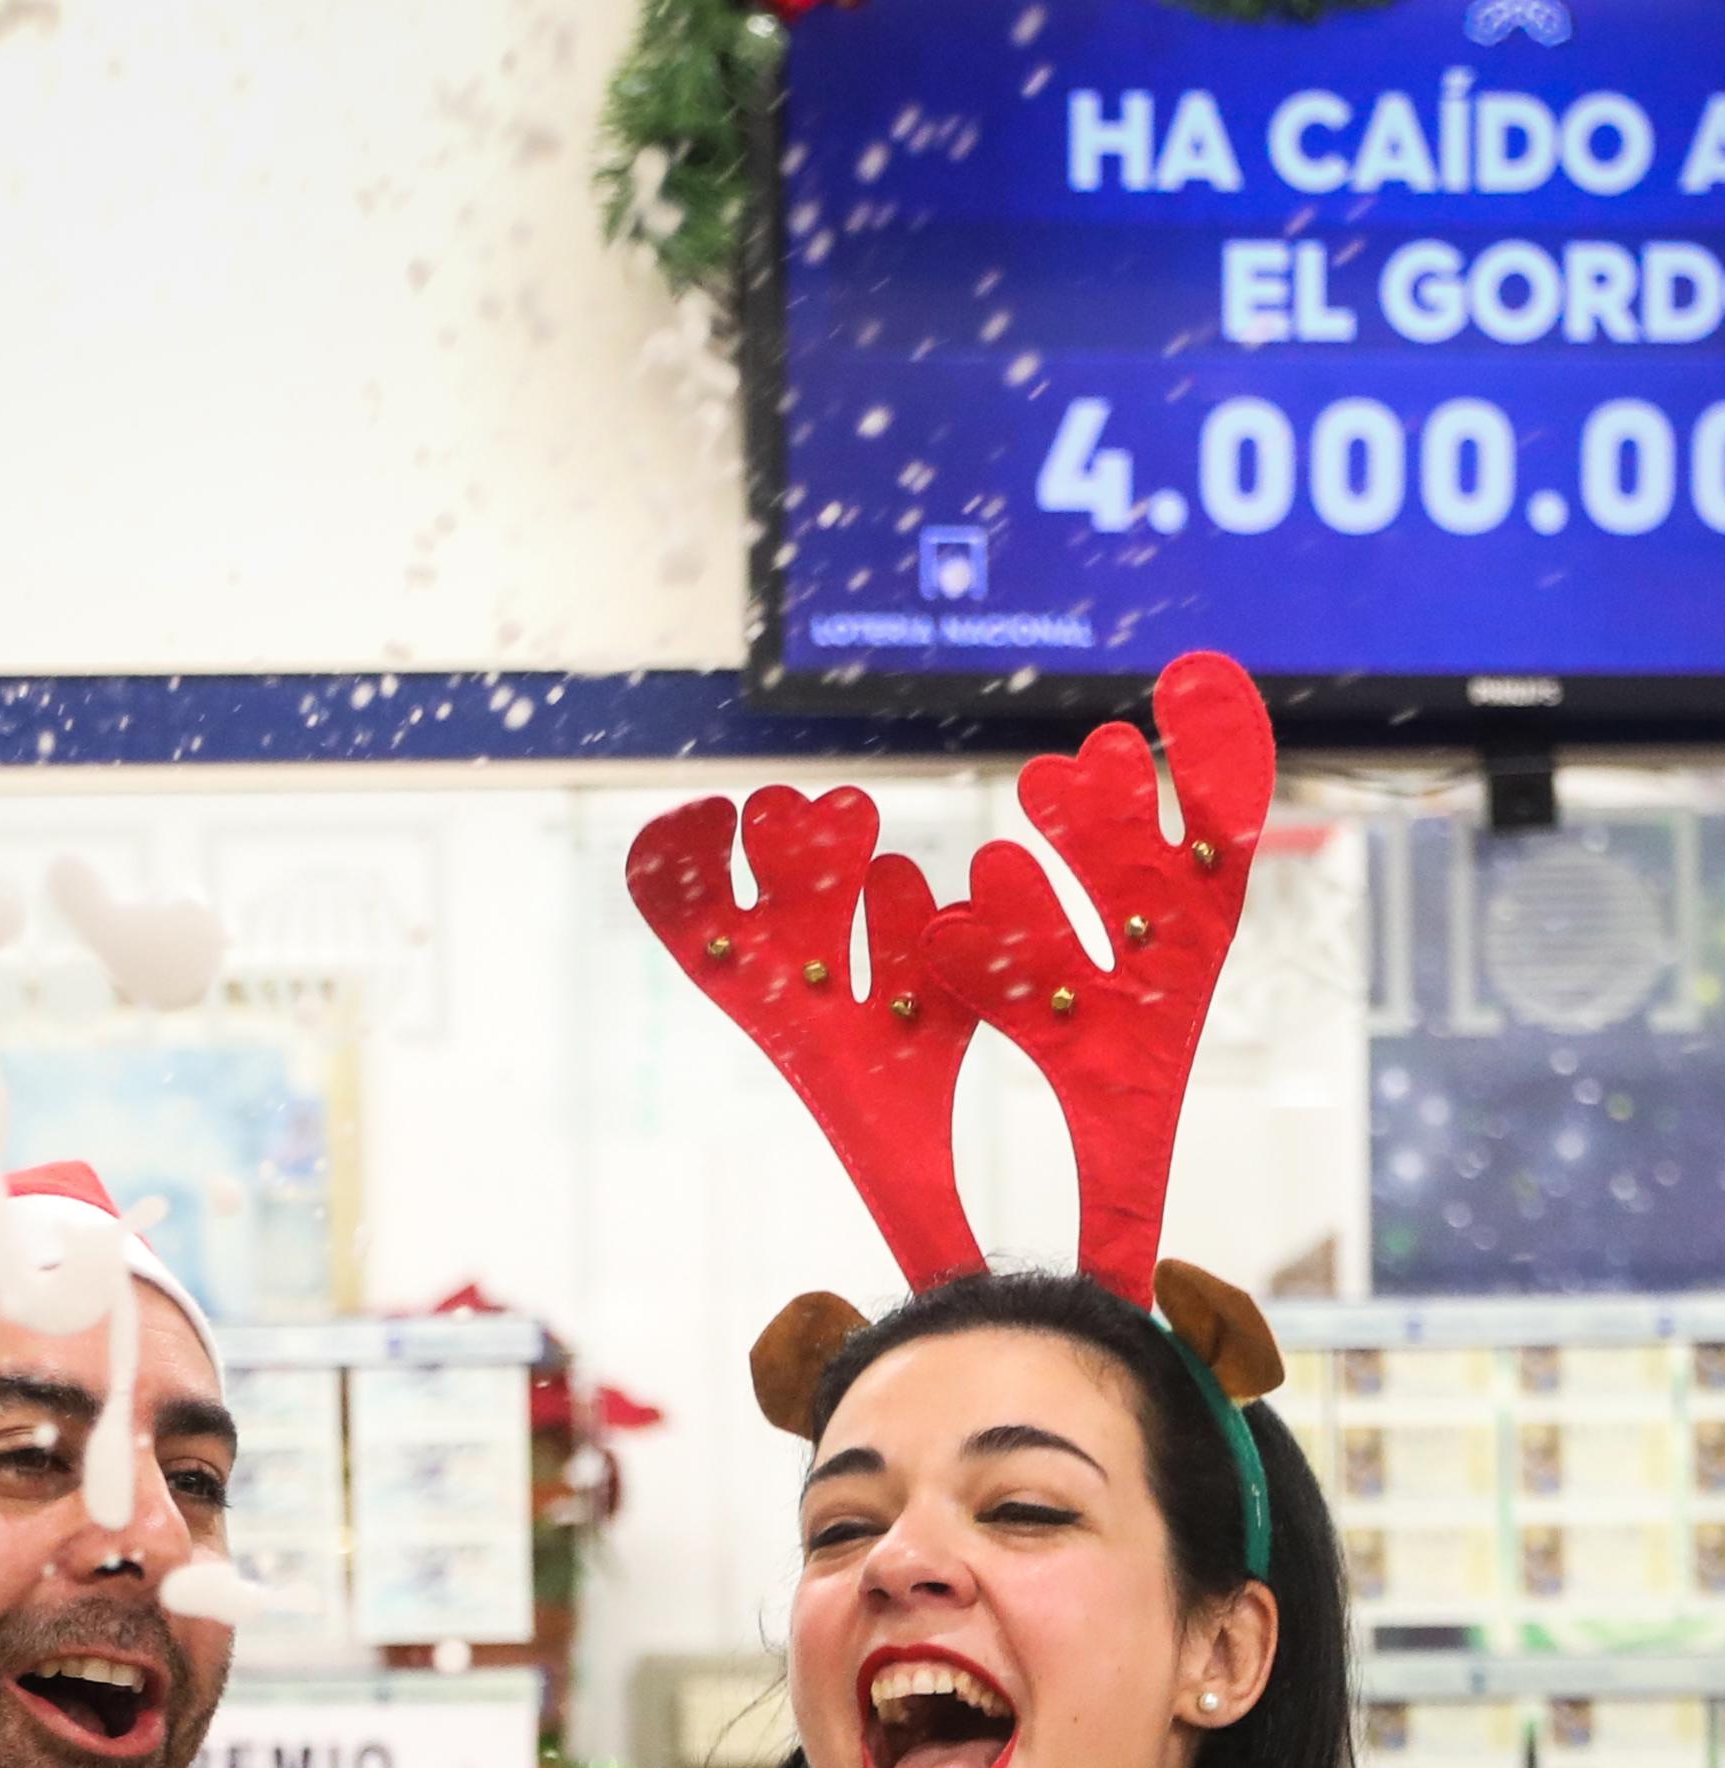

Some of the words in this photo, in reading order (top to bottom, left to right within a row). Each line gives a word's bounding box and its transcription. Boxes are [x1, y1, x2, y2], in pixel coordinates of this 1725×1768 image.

[1069, 86, 1242, 195] HA
[1267, 66, 1656, 197] CAÍDO
[1222, 242, 1356, 342] EL
